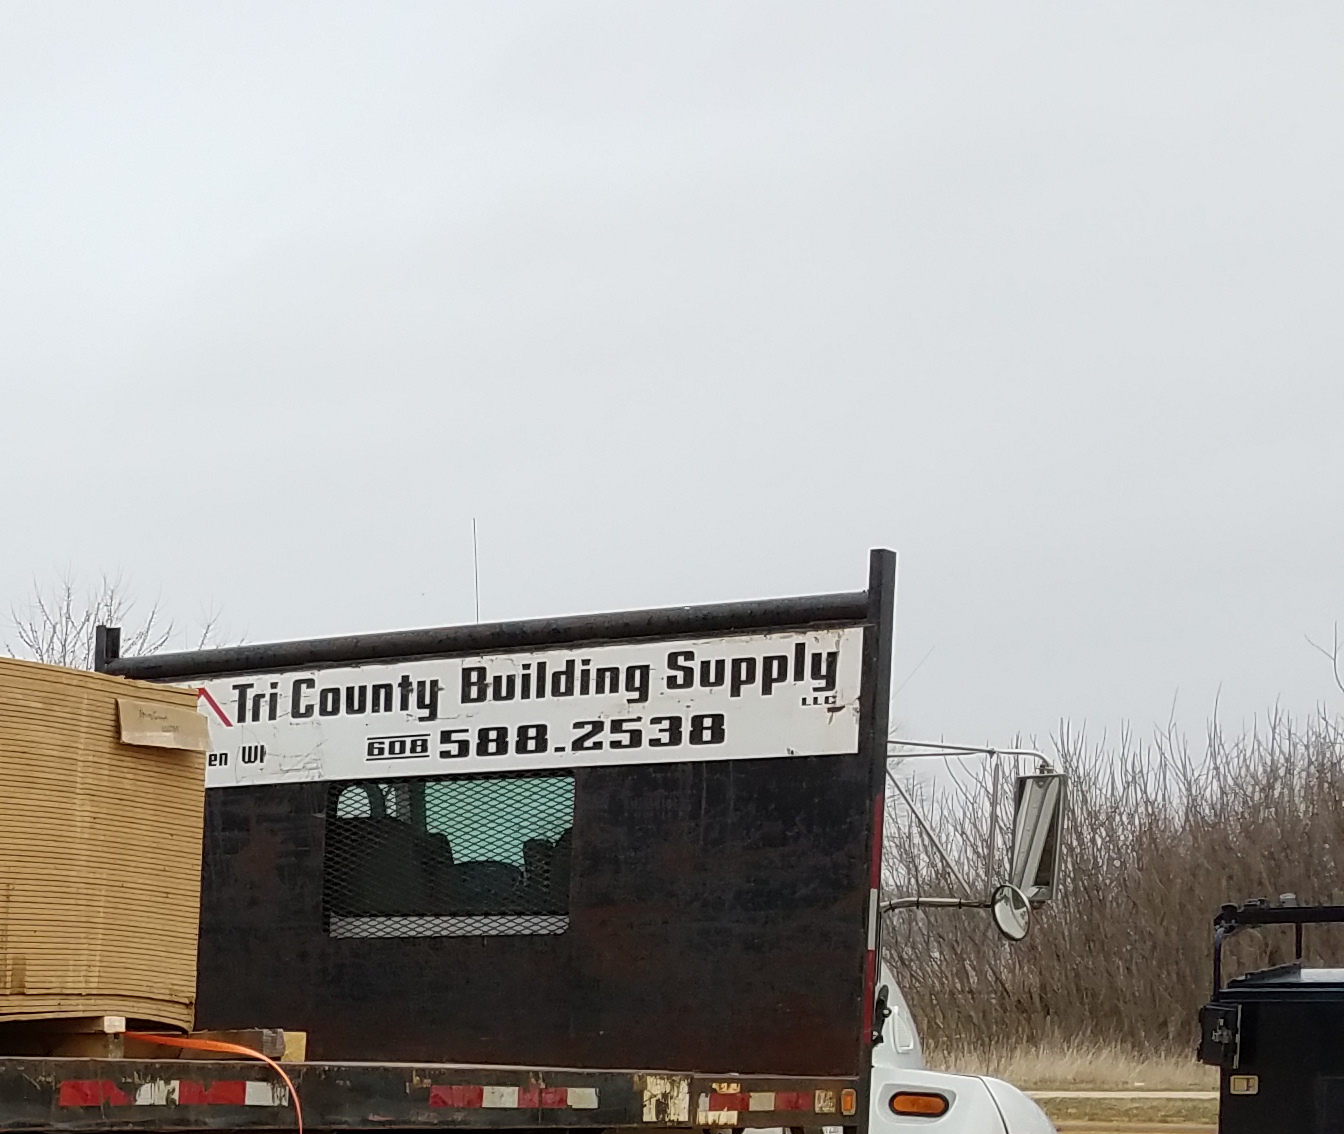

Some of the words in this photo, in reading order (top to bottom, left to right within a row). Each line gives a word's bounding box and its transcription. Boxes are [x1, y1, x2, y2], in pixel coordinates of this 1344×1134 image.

[232, 681, 280, 724] Tri
[290, 674, 440, 722] County
[460, 658, 651, 705] Building
[666, 641, 840, 698] Supply
[801, 694, 838, 707] LLC
[367, 738, 429, 757] 608
[439, 713, 726, 759] 588.2538
[208, 752, 228, 767] en
